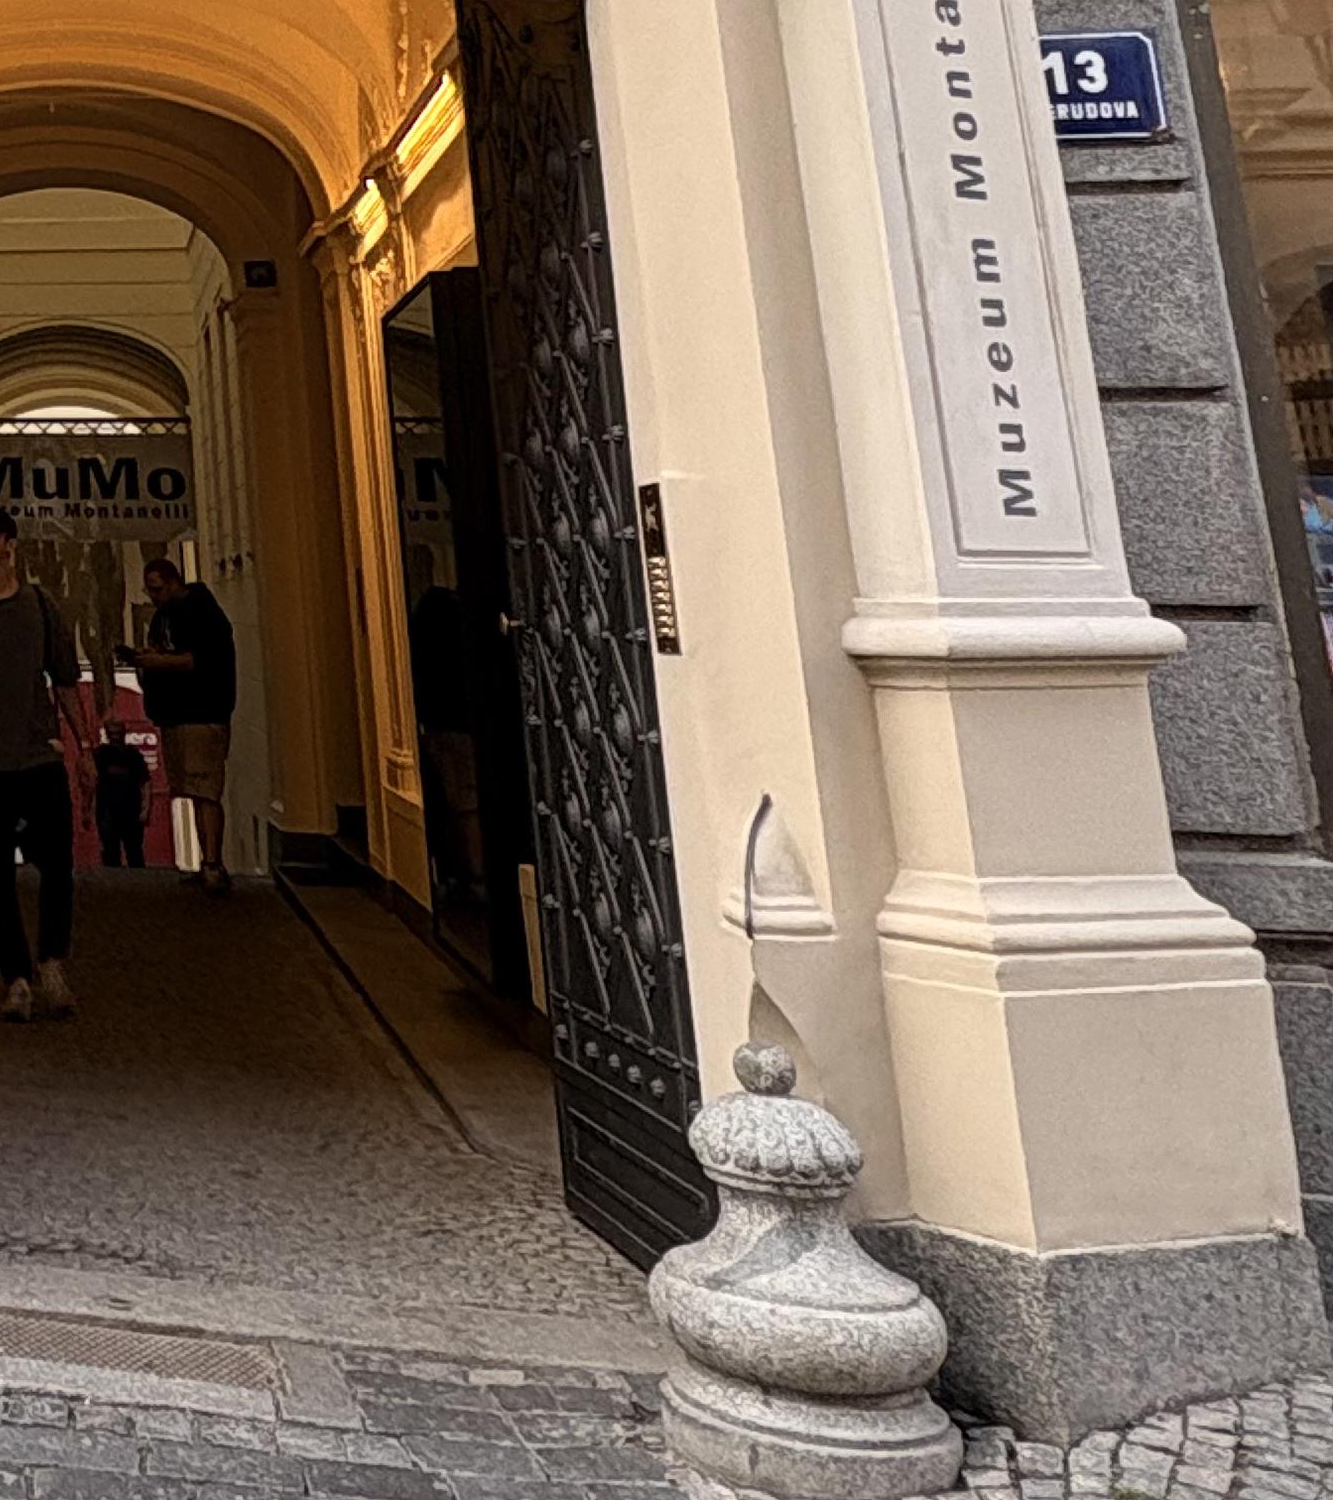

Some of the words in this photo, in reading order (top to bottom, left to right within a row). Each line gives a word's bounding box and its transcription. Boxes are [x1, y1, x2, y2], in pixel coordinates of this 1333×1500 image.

[1042, 50, 1109, 95] 13
[1049, 100, 1140, 120] RUDOVA
[973, 237, 1038, 518] Muzeum
[66, 503, 190, 519] Montanelli
